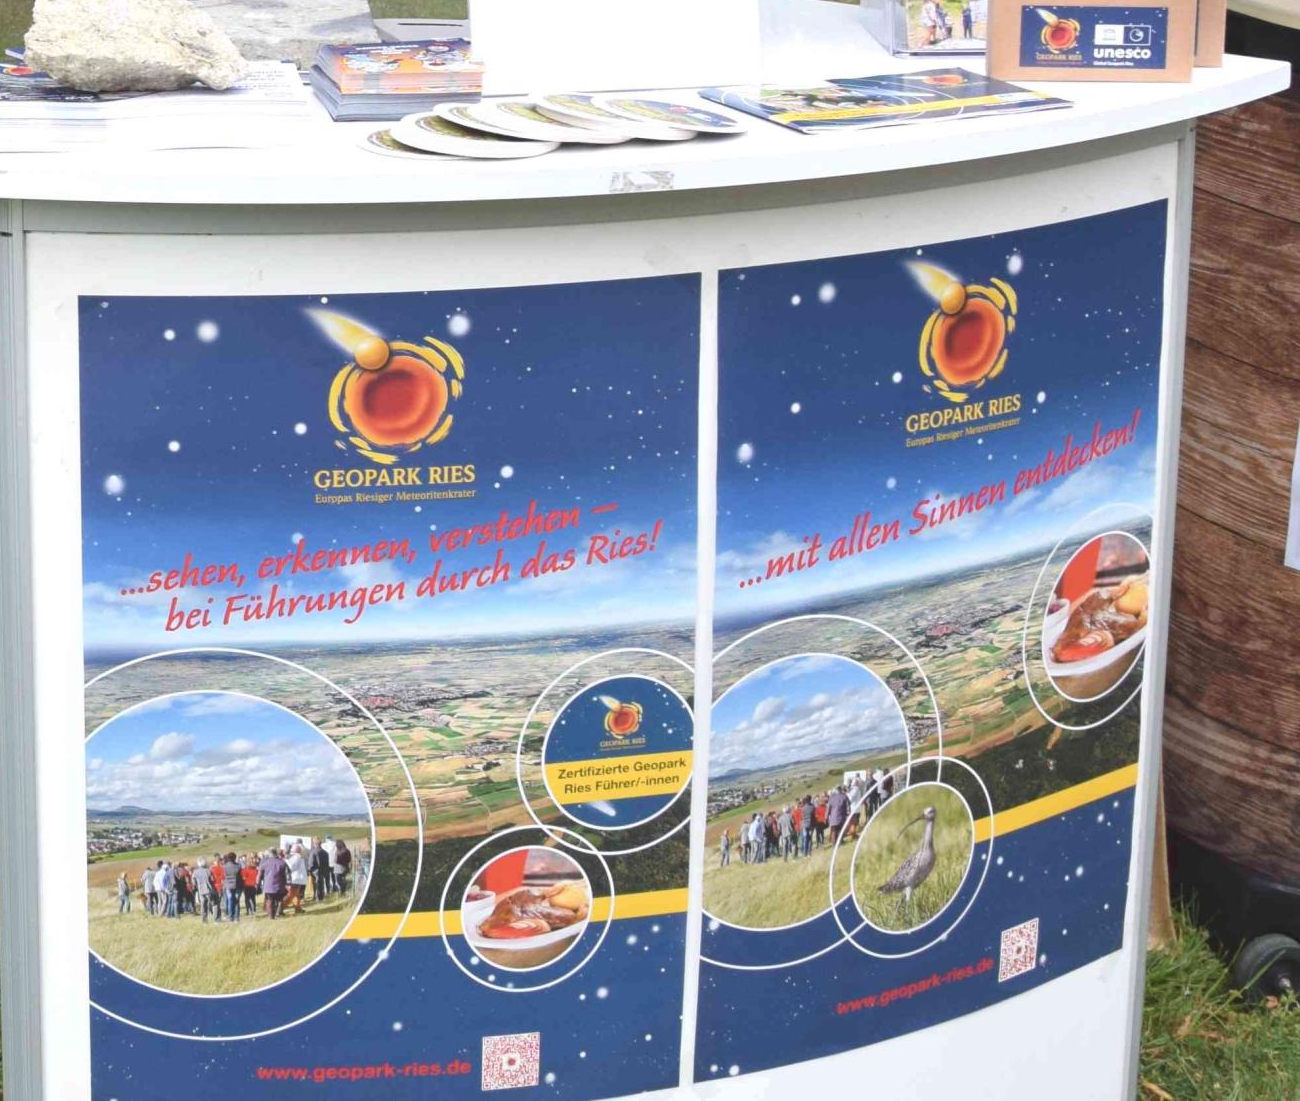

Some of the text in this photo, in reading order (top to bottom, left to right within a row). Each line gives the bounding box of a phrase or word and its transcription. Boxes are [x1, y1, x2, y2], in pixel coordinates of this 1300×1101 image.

[1092, 47, 1152, 59] unesco
[905, 393, 1021, 433] GEOPARK RIES
[905, 417, 1021, 448] Europas Riesiger Meteoritenkrater
[313, 464, 476, 489] GEOPARK RIES
[828, 512, 901, 562] allen
[908, 479, 1006, 535] Sinnen
[1013, 407, 1142, 497] entdecken!
[315, 489, 477, 505] Europas Riesiger Meteoritenkrater
[120, 499, 581, 597] ...sehen, erkennen, verstehen
[164, 520, 665, 633] bei Führungen durch das Ries!
[600, 737, 646, 748] GEOPARK RIES
[557, 757, 687, 780] Zertifizierte Geopark
[564, 775, 680, 795] Ries Führer/-innen
[836, 956, 995, 1016] www.geopark-ries.de
[256, 1059, 472, 1084] www.geopark-ries.de
